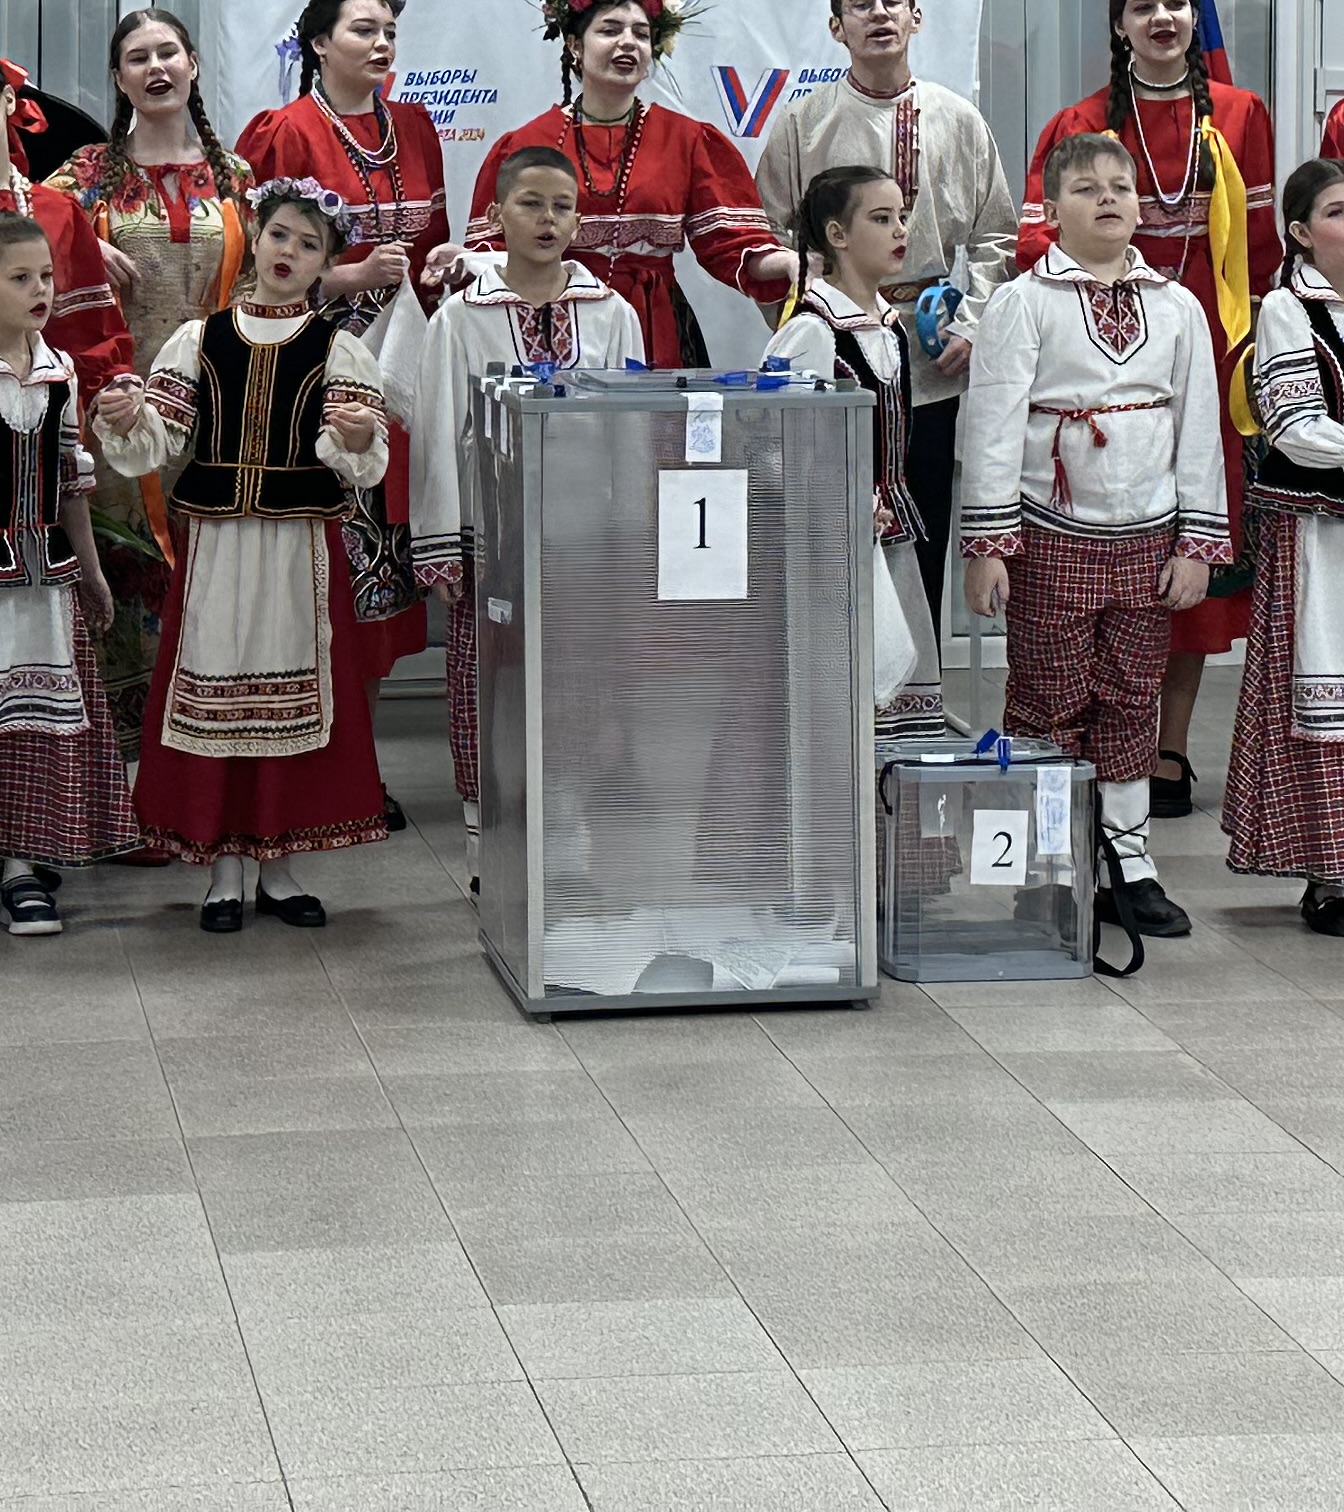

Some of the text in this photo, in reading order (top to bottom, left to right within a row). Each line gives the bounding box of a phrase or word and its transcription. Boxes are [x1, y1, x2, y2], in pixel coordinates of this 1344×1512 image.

[404, 69, 478, 86] ВЫБОРЫ
[693, 497, 712, 549] 1
[991, 831, 1013, 868] 2
